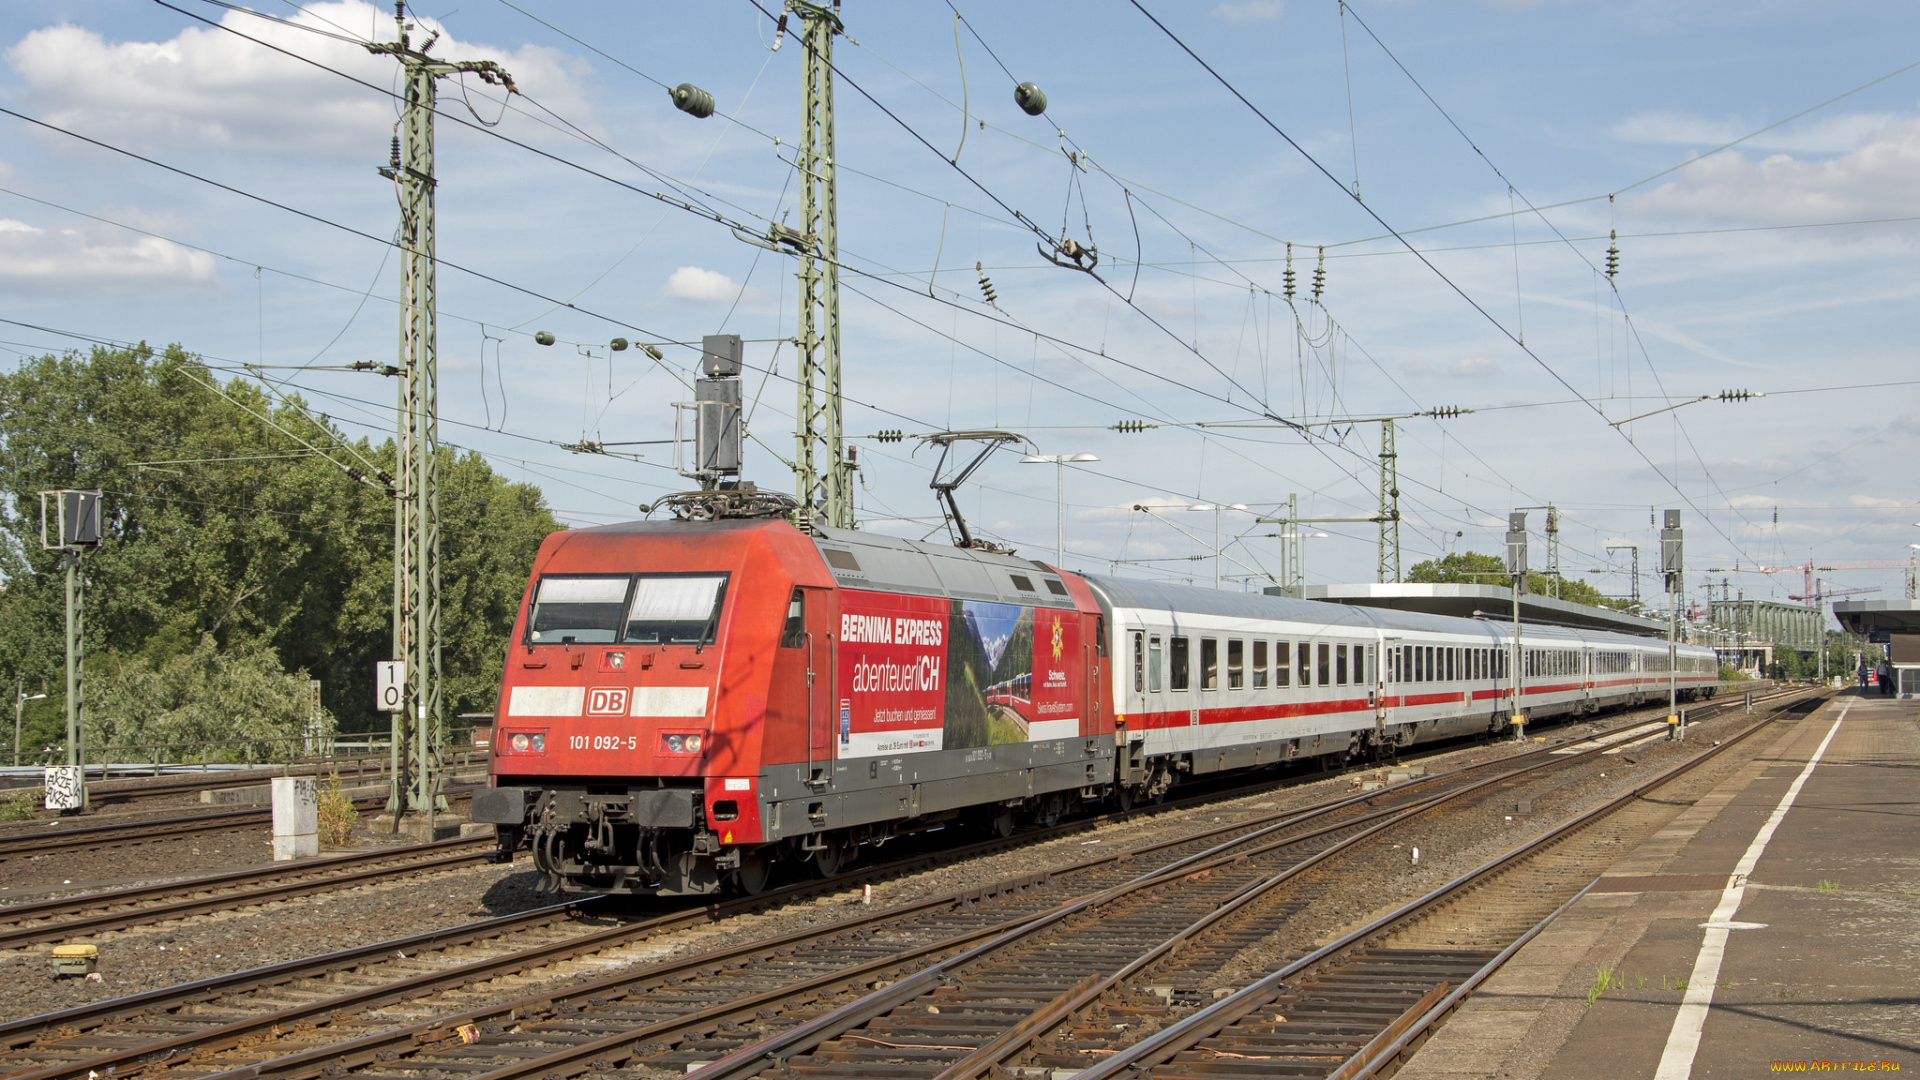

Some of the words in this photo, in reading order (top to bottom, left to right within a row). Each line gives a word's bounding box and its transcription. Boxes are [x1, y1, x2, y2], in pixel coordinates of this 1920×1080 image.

[840, 613, 892, 645] BERNINA
[895, 617, 942, 647] EXPRESS
[1858, 624, 1864, 633] 5
[1870, 624, 1876, 633] E
[387, 664, 394, 684] 1
[853, 653, 940, 692] abenteuerliCH
[384, 686, 399, 706] 0
[590, 690, 626, 713] DB
[873, 708, 886, 723] Jetzt
[886, 707, 903, 723] buchen
[904, 707, 914, 722] und
[569, 735, 589, 750] 101
[594, 735, 637, 750] 092-5
